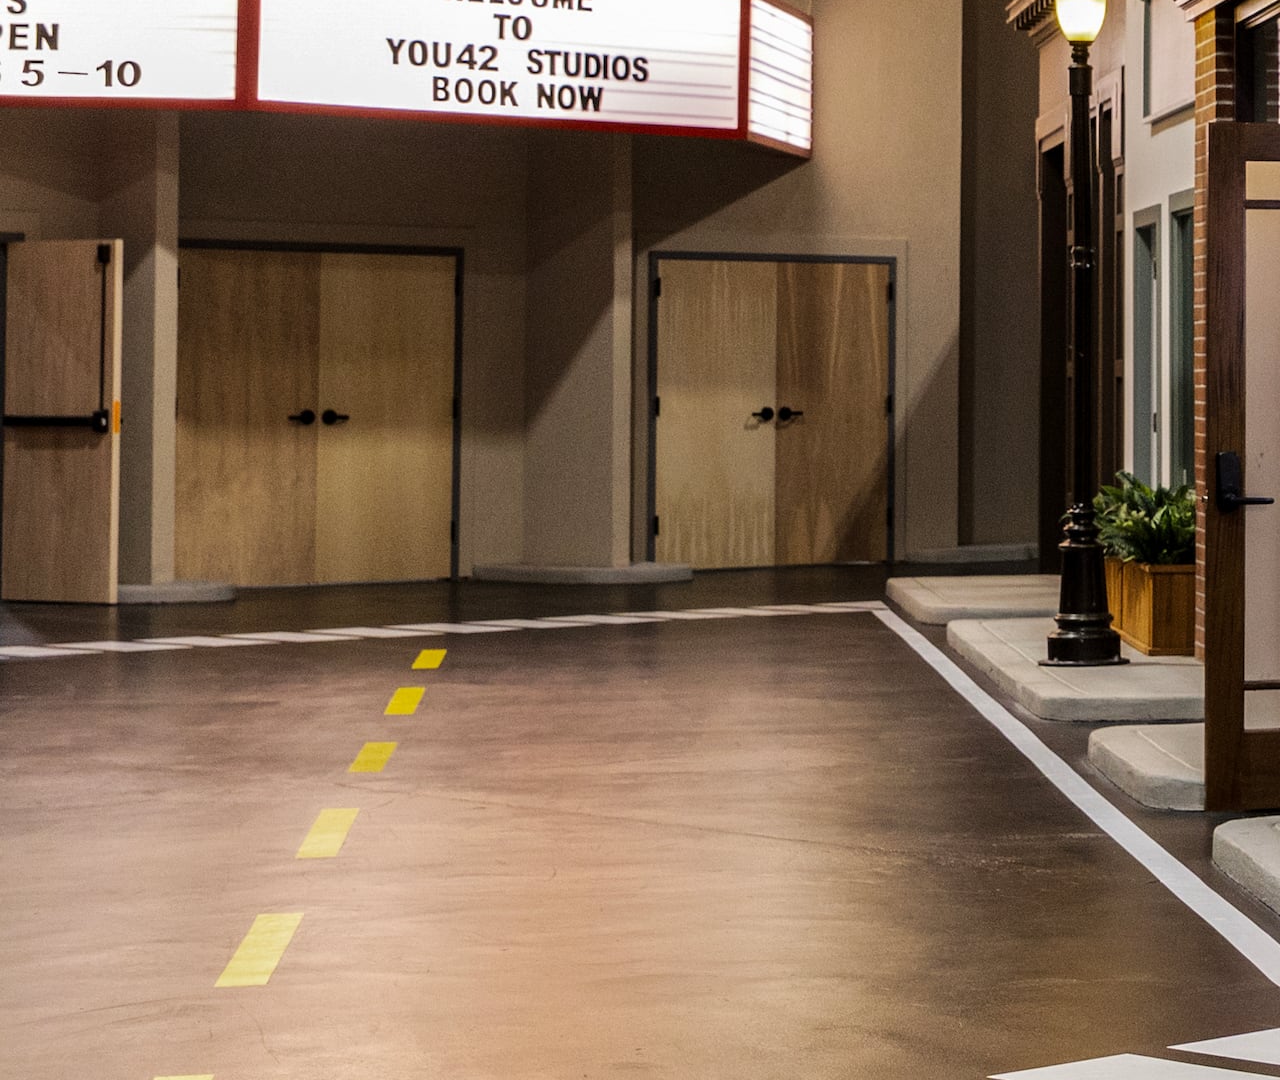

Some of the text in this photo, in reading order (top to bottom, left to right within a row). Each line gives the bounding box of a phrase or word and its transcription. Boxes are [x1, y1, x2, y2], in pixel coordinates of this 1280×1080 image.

[0, 23, 60, 50] EN
[493, 14, 532, 40] TO
[386, 38, 650, 82] YOU42 STUDIOS
[432, 76, 604, 112] BOOK NOW
